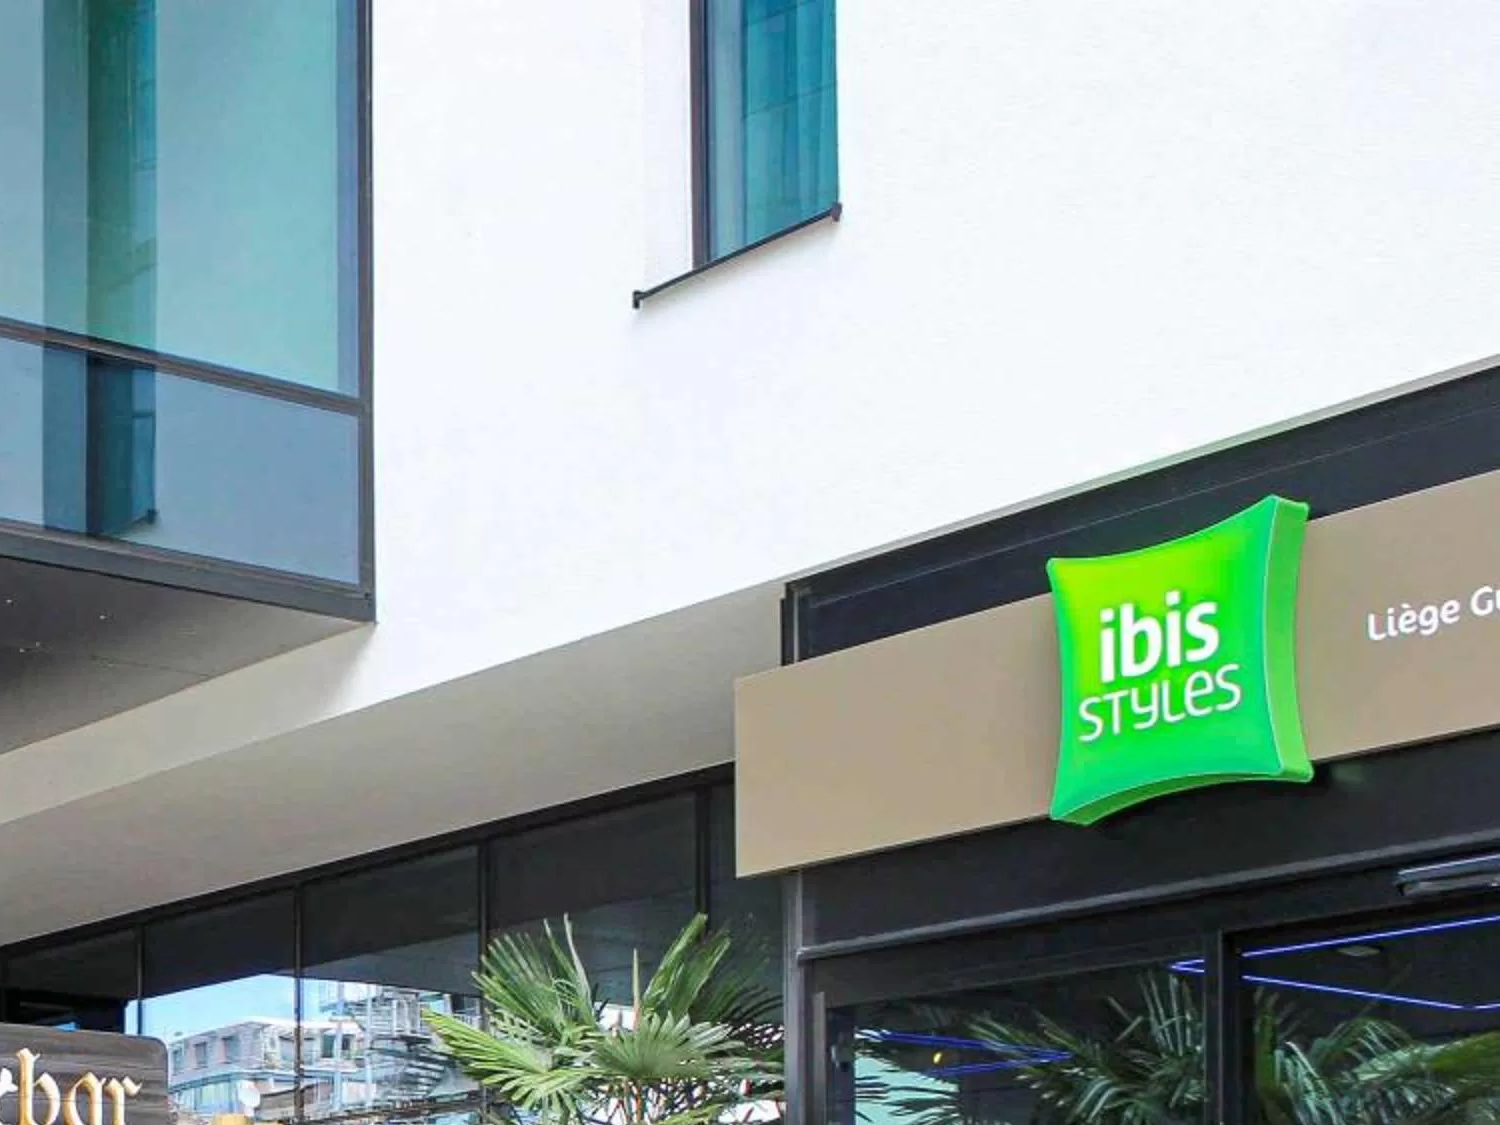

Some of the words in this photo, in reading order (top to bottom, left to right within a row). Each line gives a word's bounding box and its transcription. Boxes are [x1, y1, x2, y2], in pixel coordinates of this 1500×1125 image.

[1099, 590, 1220, 684] ibis
[1367, 599, 1461, 640] Liège
[1469, 585, 1500, 616] G
